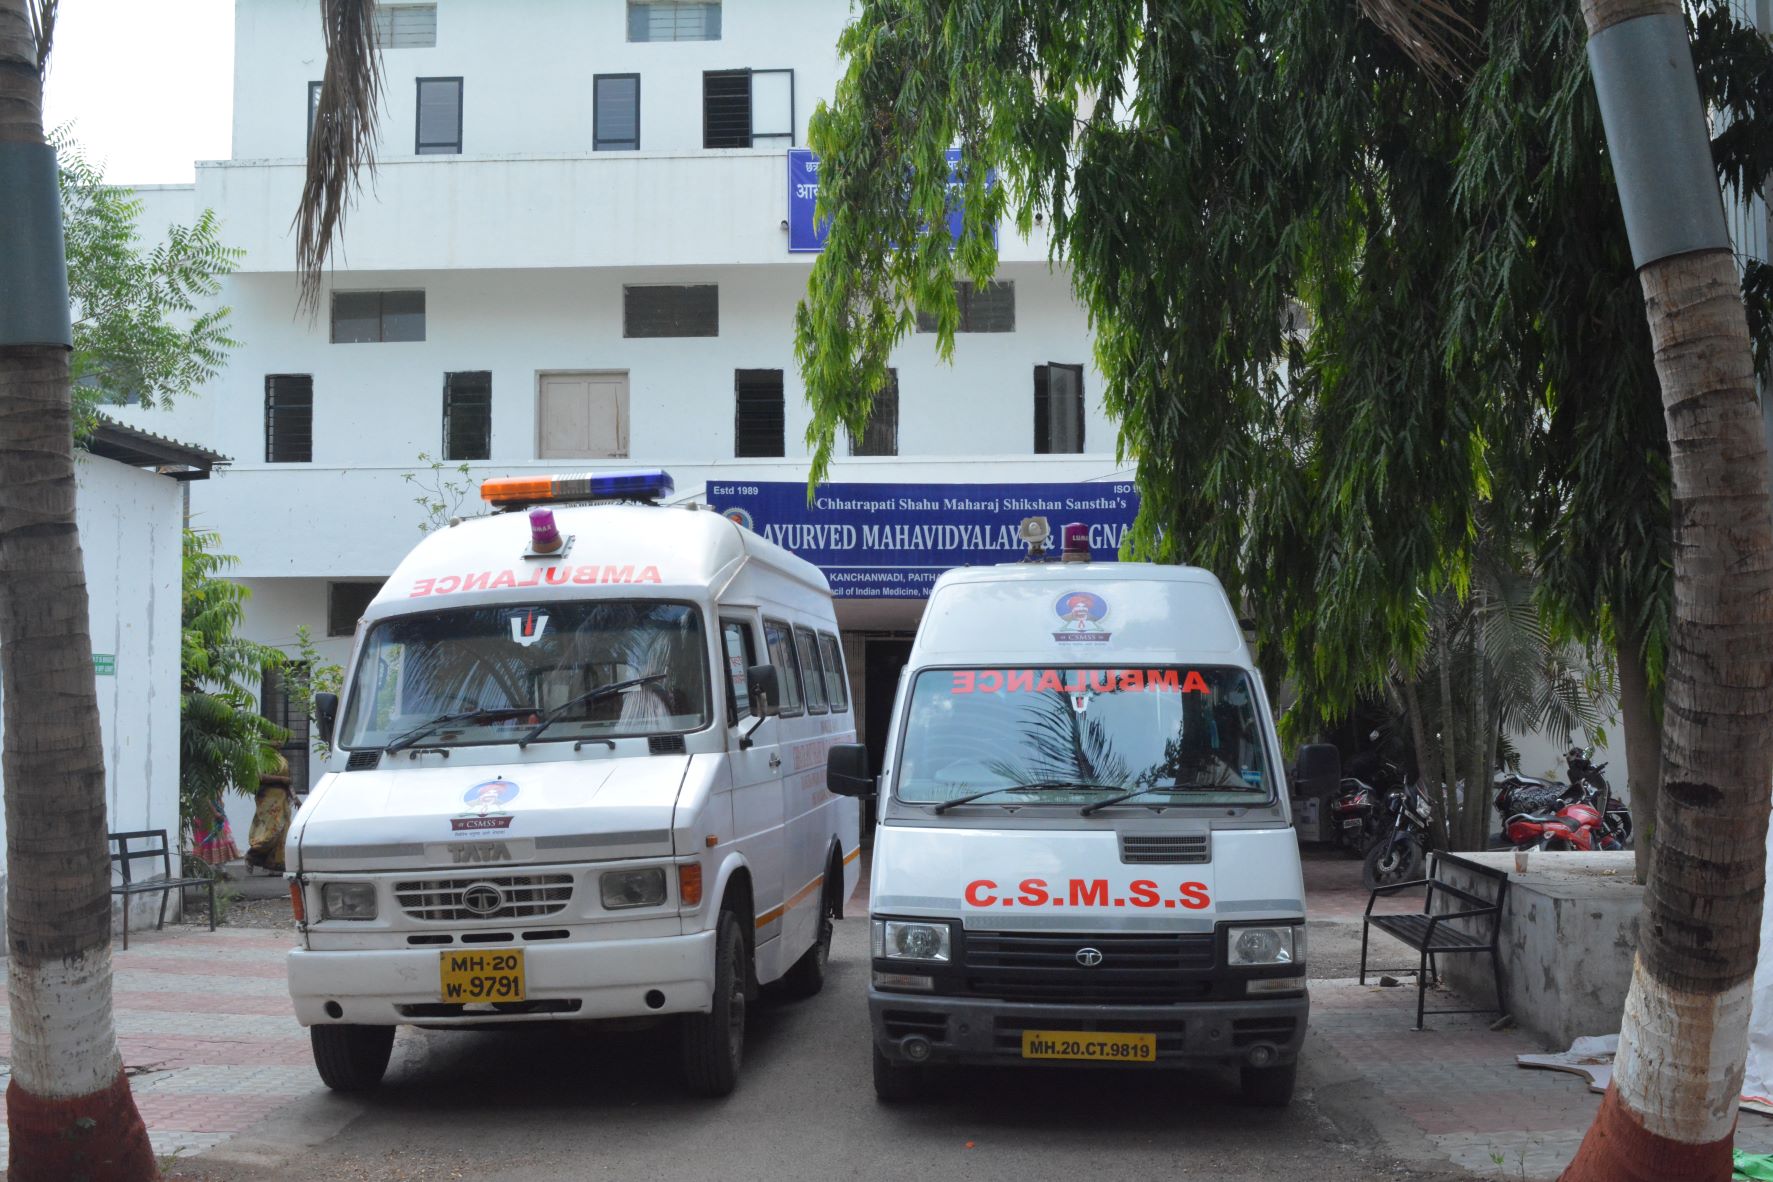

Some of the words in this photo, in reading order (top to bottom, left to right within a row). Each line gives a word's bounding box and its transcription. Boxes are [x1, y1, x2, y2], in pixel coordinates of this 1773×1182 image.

[713, 486, 734, 495] Estd
[738, 486, 759, 495] 1989
[1113, 485, 1131, 494] ISO
[816, 497, 896, 513] Chhatrapati
[899, 498, 939, 511] Shahu
[943, 498, 1000, 513] Maharaj
[1003, 498, 1062, 511] Shikshan
[1066, 496, 1127, 510] Sanstha's
[763, 524, 857, 550] AYURVED
[830, 573, 905, 583] KANCHANWADI,
[845, 587, 855, 596] of
[855, 587, 881, 596] Indian
[882, 587, 921, 597] Medicine,
[466, 819, 497, 829] CSMSS
[448, 842, 512, 863] TATA
[964, 878, 1211, 910] C.S.M.S.S
